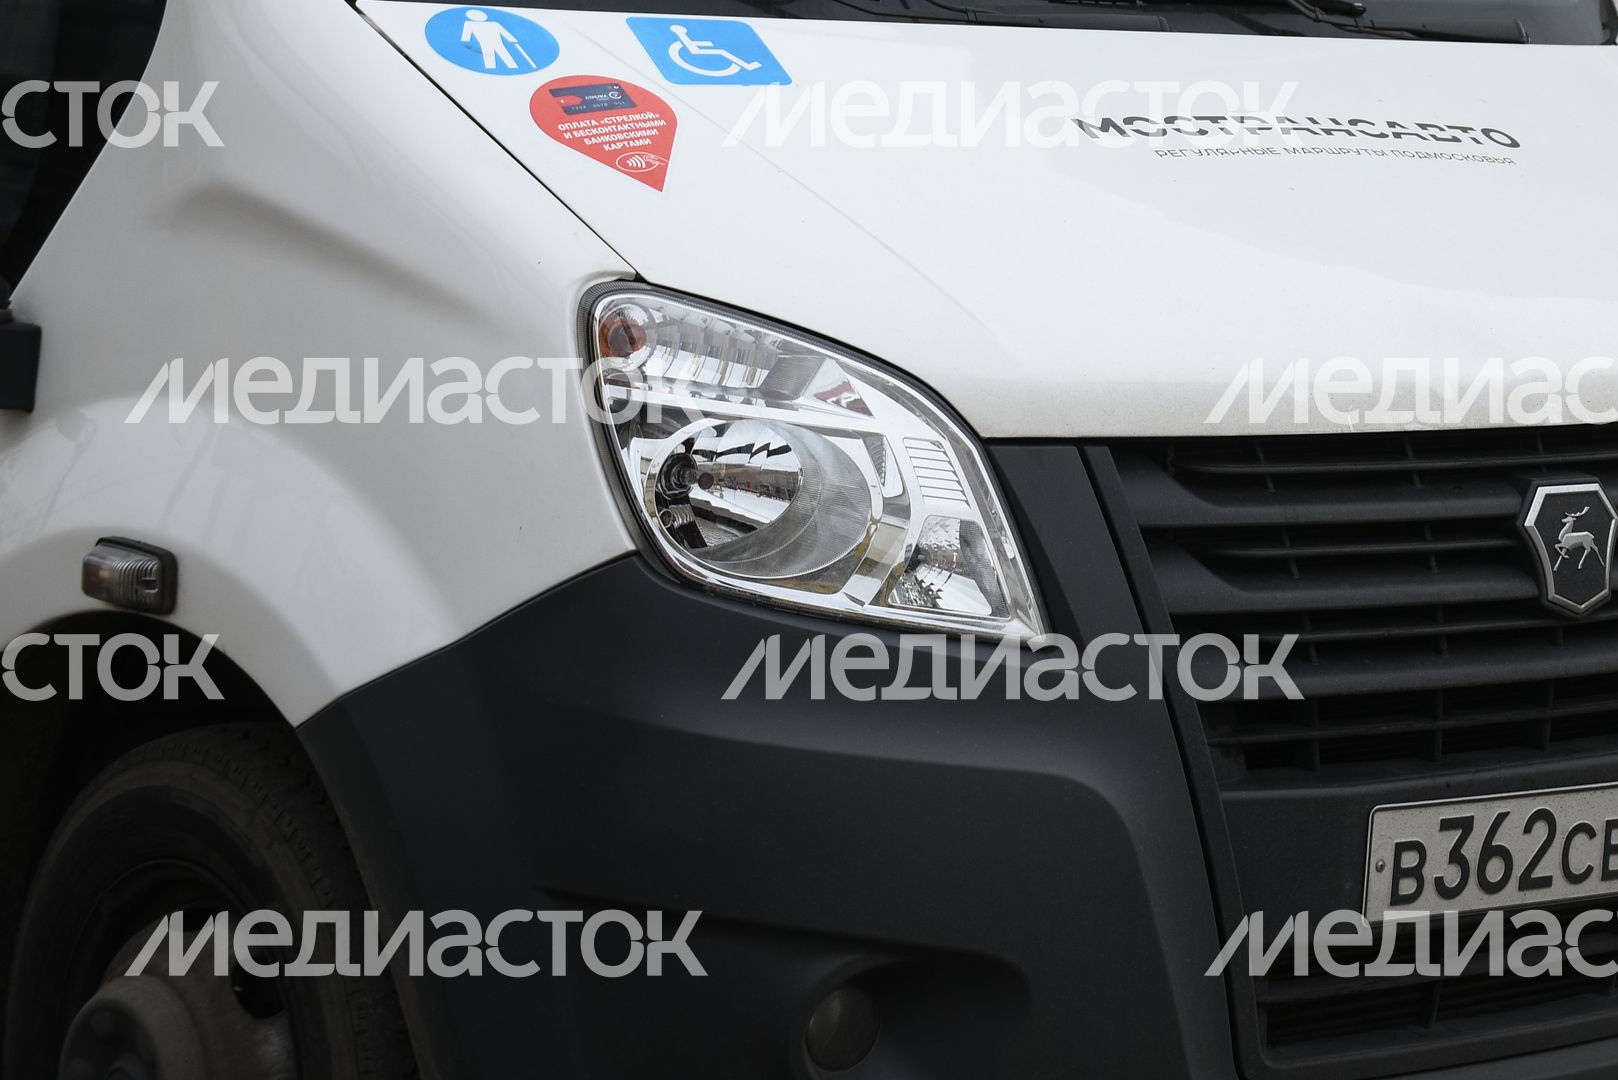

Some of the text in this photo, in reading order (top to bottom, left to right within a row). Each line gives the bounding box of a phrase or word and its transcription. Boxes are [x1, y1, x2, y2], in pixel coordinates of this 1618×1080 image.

[557, 111, 660, 132] ОПЛАТА «СТРЕЛКОЙ»
[574, 119, 667, 138] БЕСКОНТАКТНЫМИ
[583, 128, 659, 145] БАНКОВСКИМИ
[1073, 115, 1521, 149] МОСТРАНСАВТО
[603, 138, 652, 152] КАРТАМИ
[1154, 146, 1517, 165] РЕГУЛЯРНЫЕ МАРШРУТЫ ПОДМОСКОВЬЯ
